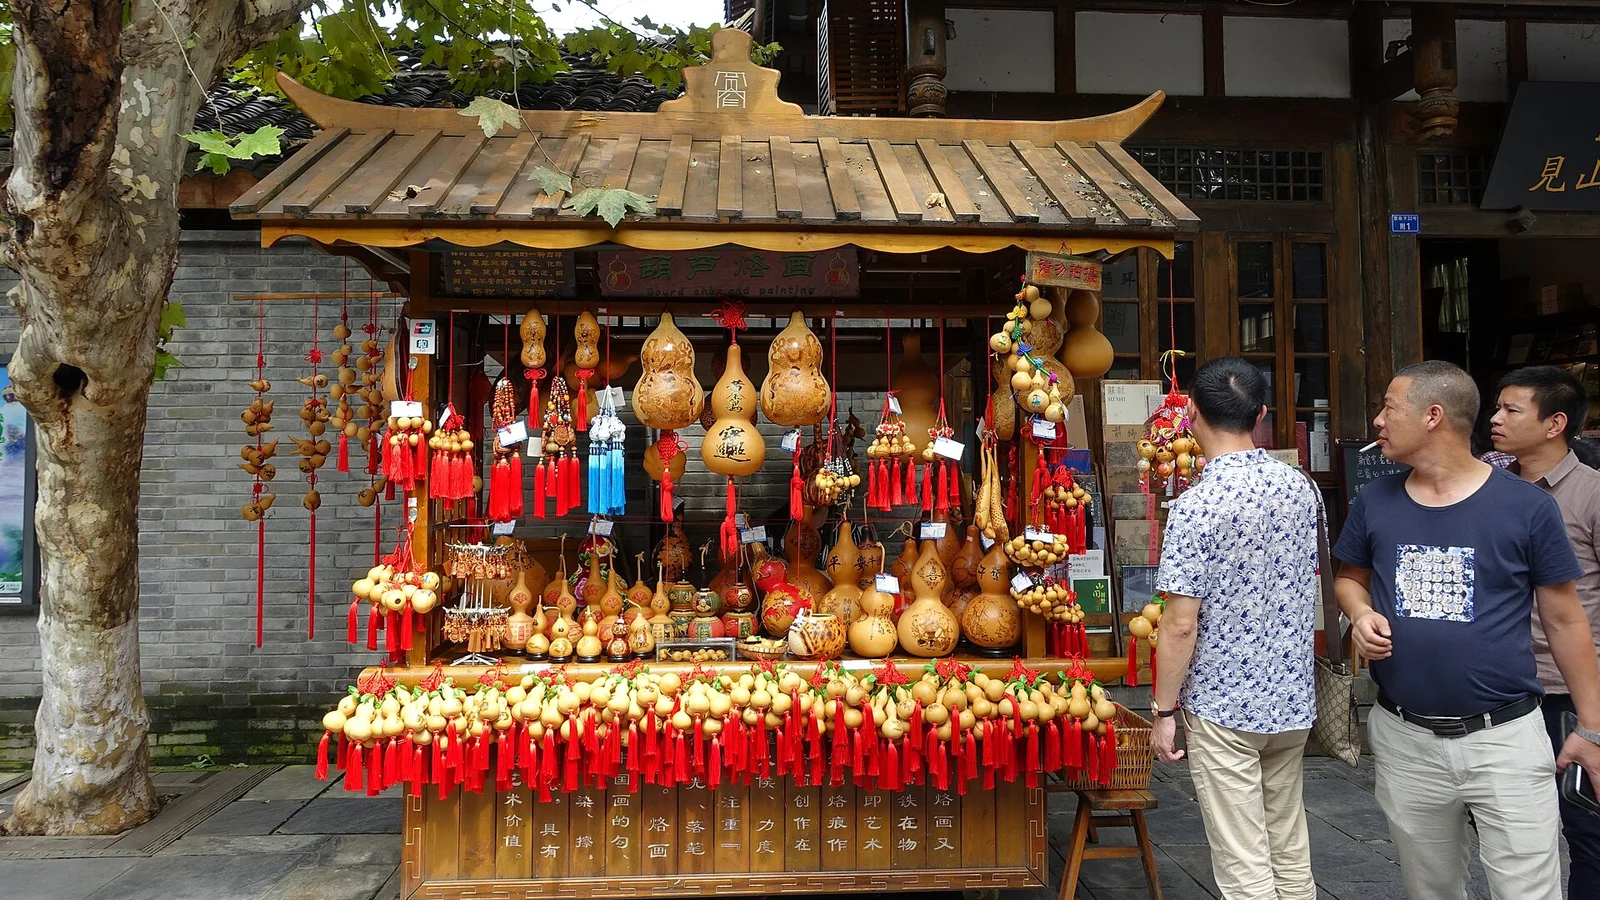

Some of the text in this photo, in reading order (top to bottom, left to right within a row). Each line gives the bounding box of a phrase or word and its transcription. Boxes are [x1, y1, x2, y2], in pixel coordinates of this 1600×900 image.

[638, 254, 820, 281] 葫芦烙画
[758, 285, 816, 298] painting
[863, 795, 883, 851] 即艺术
[897, 778, 918, 851] 铁在物
[933, 792, 954, 851] 烙画又
